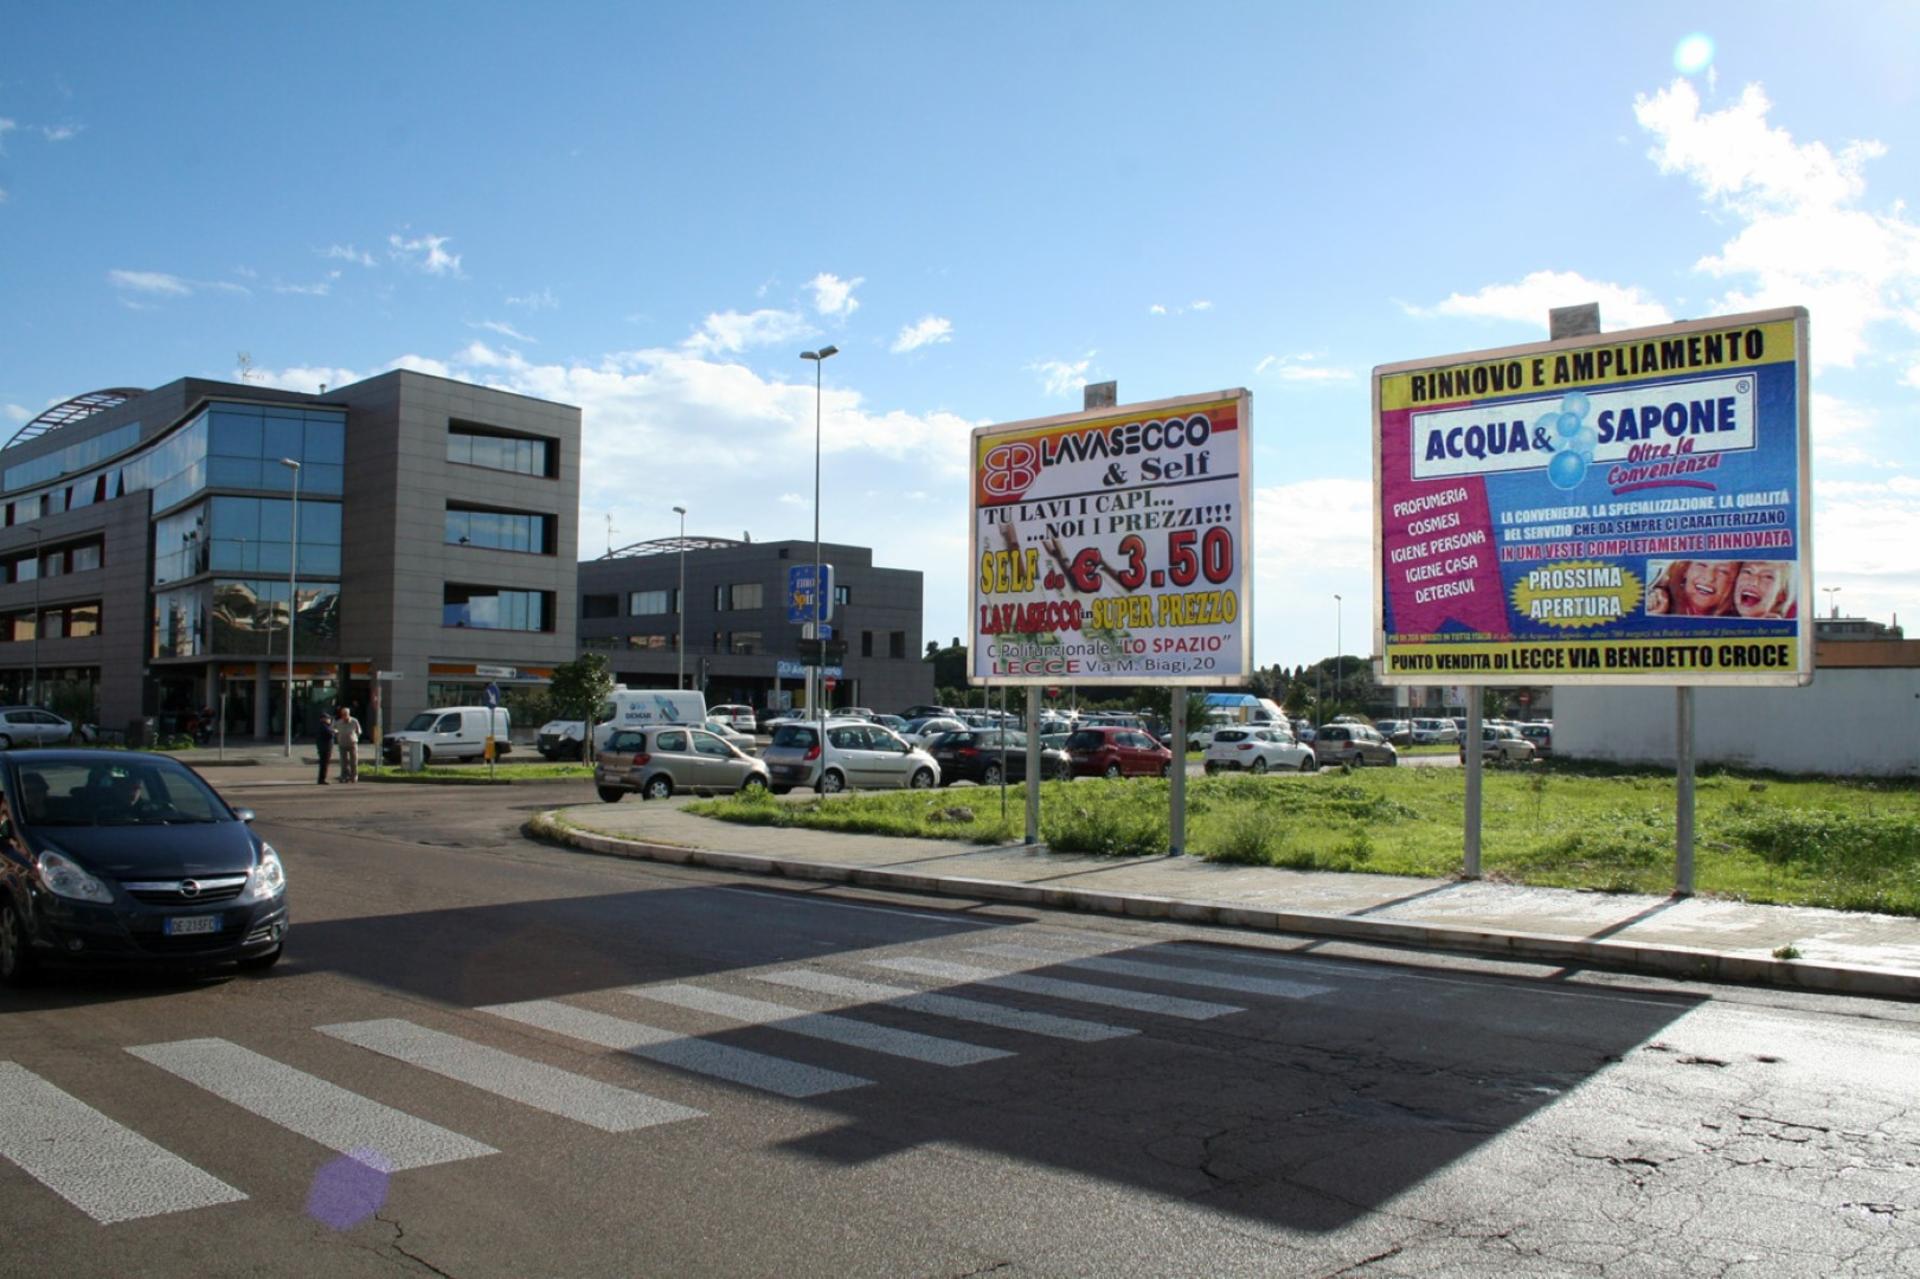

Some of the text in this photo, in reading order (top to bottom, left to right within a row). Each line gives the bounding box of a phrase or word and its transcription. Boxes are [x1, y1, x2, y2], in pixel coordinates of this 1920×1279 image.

[1411, 328, 1764, 402] RINNOVO E AMPLIAMENTO
[1041, 414, 1211, 467] LAVASECCO
[1426, 420, 1531, 461] ACQUA
[1531, 427, 1555, 453] &
[1597, 396, 1736, 444] SAPONE
[1626, 435, 1696, 464] Oltre la
[1102, 451, 1211, 487] & Self
[1607, 452, 1722, 486] Convenienza
[984, 489, 1175, 525] TU LAVI I CAPI...
[1393, 487, 1469, 518] PROFUMERIA
[1501, 511, 1514, 525] LA
[1593, 504, 1607, 518] LA
[1719, 493, 1735, 509] LA
[1093, 517, 1101, 535] I
[1108, 503, 1233, 534] PREZZI!!!
[1407, 511, 1461, 537] COSMESI
[1523, 523, 1573, 540] SERVIZIO
[1573, 522, 1596, 537] CHE
[1599, 520, 1614, 534] DA
[1616, 517, 1662, 534] SEMPRE
[1665, 517, 1678, 532] CI
[1680, 509, 1786, 531] CARATTERIZZANO
[980, 547, 1039, 594] SELF
[1071, 547, 1104, 594] €
[1117, 525, 1234, 589] 3.50
[1391, 529, 1487, 565] IGIENE PERSONA
[1501, 529, 1792, 561] IN UNA VESTE COMPLETAMENTE RINNOVATA
[1405, 554, 1478, 584] IGIENE CASA
[1528, 566, 1623, 591] PROSSIMA
[1415, 578, 1475, 604] DETERSIVI
[980, 588, 1238, 634] LAVASECCO in SUPER PREZZO
[1529, 595, 1622, 620] APERTURA
[991, 659, 1081, 675] LECCE
[1086, 660, 1115, 674] Via
[1116, 658, 1139, 673] M.
[1391, 644, 1790, 670] PUNTO VENDITA DI LECCE VIA BENEDETTO CROCE
